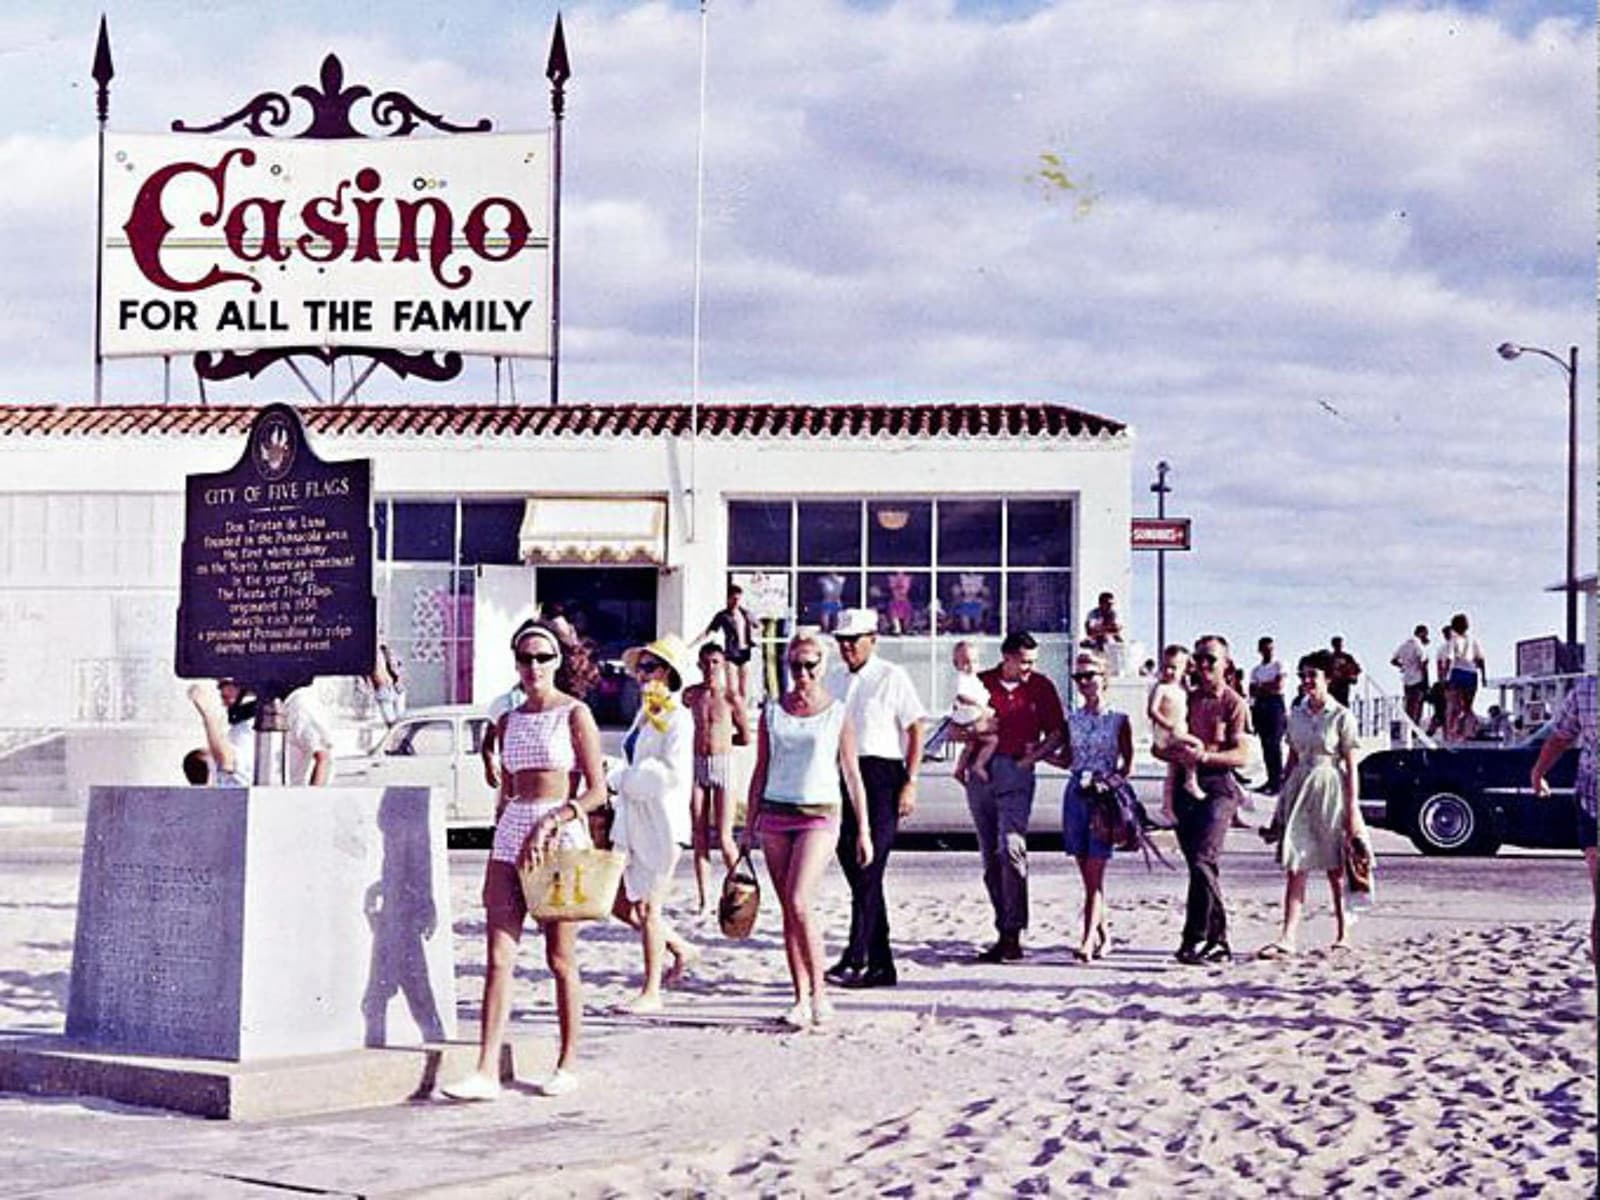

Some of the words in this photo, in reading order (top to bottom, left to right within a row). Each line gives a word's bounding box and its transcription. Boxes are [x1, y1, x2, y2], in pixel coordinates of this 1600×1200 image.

[122, 147, 532, 292] Casino
[118, 300, 197, 332] FOR
[216, 300, 288, 332] ALL
[303, 300, 372, 332] THE
[394, 300, 533, 332] FAMILY
[204, 488, 236, 504] CITY
[244, 486, 262, 502] OF
[268, 482, 299, 500] FIVE
[305, 477, 350, 499] FLAGS
[225, 521, 244, 533] Don
[248, 519, 283, 532] Tristan
[285, 517, 297, 529] de
[301, 515, 326, 528] Luna
[204, 534, 241, 548] founded
[244, 534, 254, 546] in
[257, 533, 273, 545] the
[275, 530, 321, 545] Pensacola
[223, 549, 238, 561] the
[242, 547, 262, 559] first
[267, 546, 292, 557] white
[295, 544, 328, 558] colony
[211, 562, 227, 573] the
[230, 561, 258, 573] North
[262, 559, 306, 571] American
[310, 555, 356, 568] continent
[246, 575, 261, 586] the
[265, 575, 288, 587] year
[218, 587, 234, 600] The
[237, 587, 265, 599] Fiesta
[269, 586, 280, 598] of
[229, 601, 278, 614] originated
[280, 601, 291, 610] in
[232, 615, 264, 626] selects
[267, 614, 289, 624] each
[293, 613, 316, 625] year
[206, 629, 251, 643] prominent
[311, 626, 322, 636] to
[215, 643, 245, 656] during
[249, 641, 266, 653] this
[270, 640, 301, 652] annual
